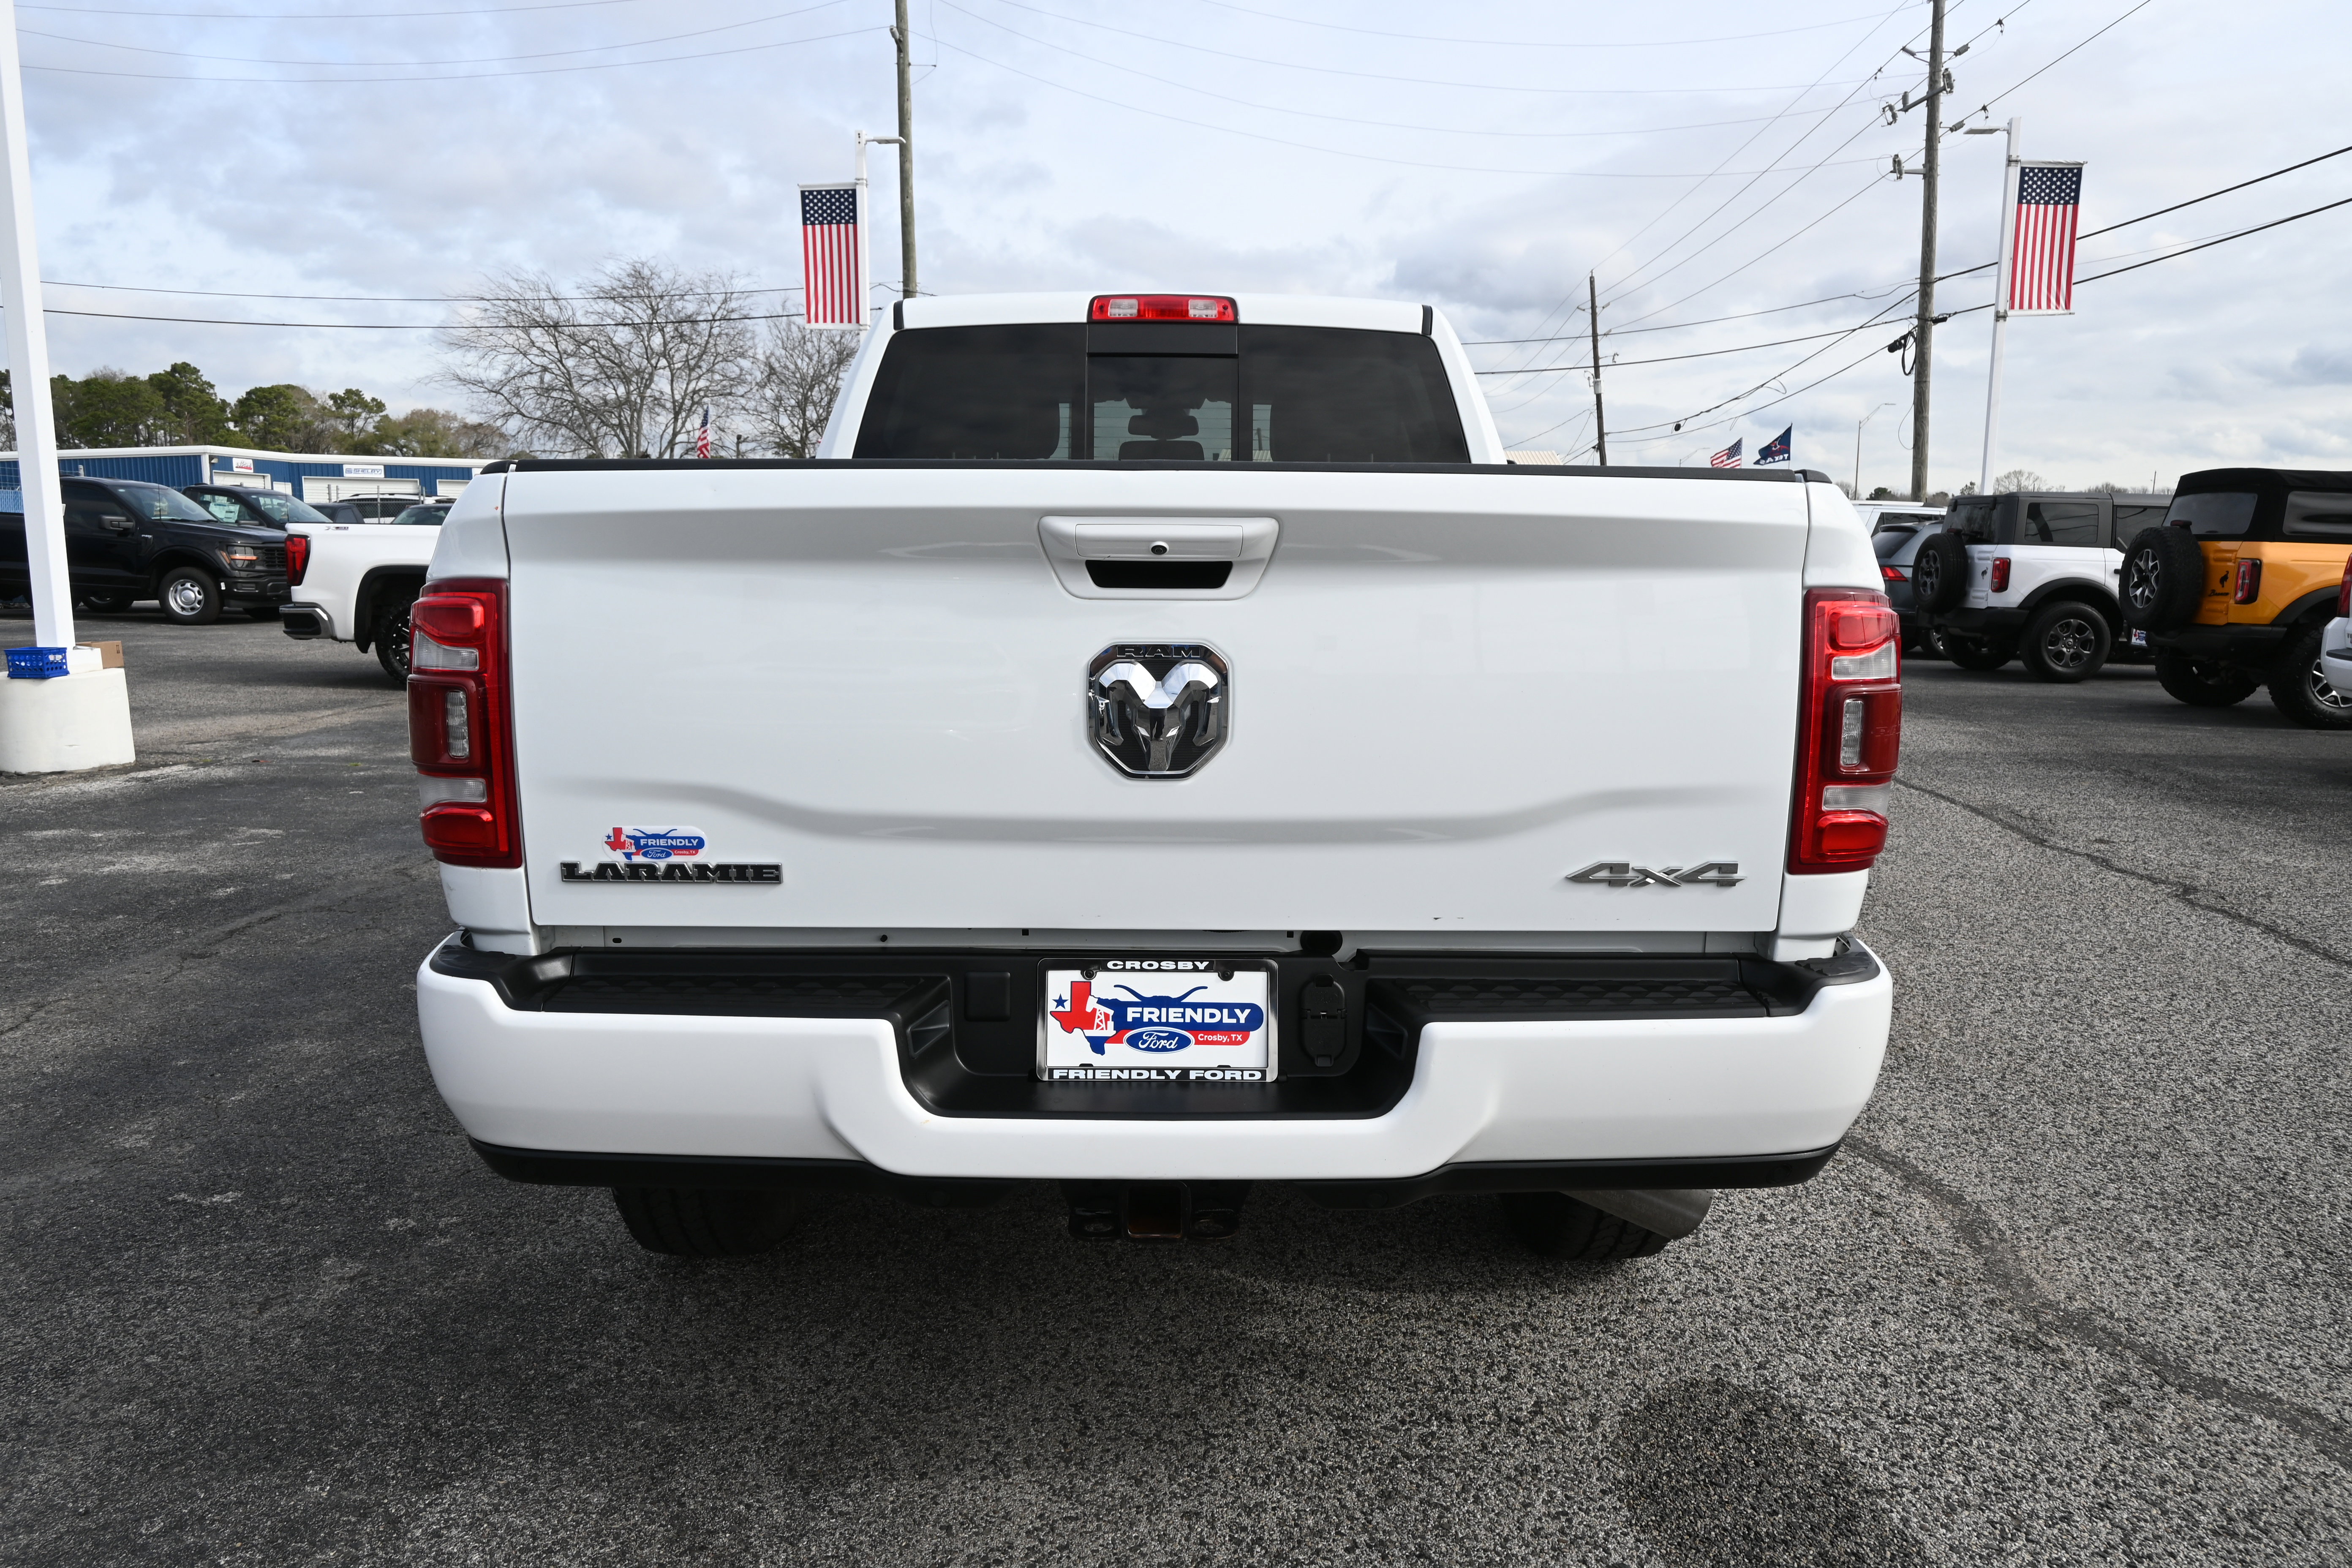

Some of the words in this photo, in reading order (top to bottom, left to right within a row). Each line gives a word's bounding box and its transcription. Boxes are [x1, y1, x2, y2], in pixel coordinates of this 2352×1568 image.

[1116, 646, 1201, 658] RAM
[647, 850, 666, 858] Ford
[561, 861, 783, 884] LARAMIE
[1107, 961, 1209, 970] CROSBY
[1127, 1007, 1251, 1024] FRIENDLY
[1138, 1032, 1179, 1049] Ford
[1198, 1033, 1229, 1043] Crosby,
[1053, 1069, 1181, 1079] FRIENDLY
[1189, 1070, 1262, 1080] FORD
